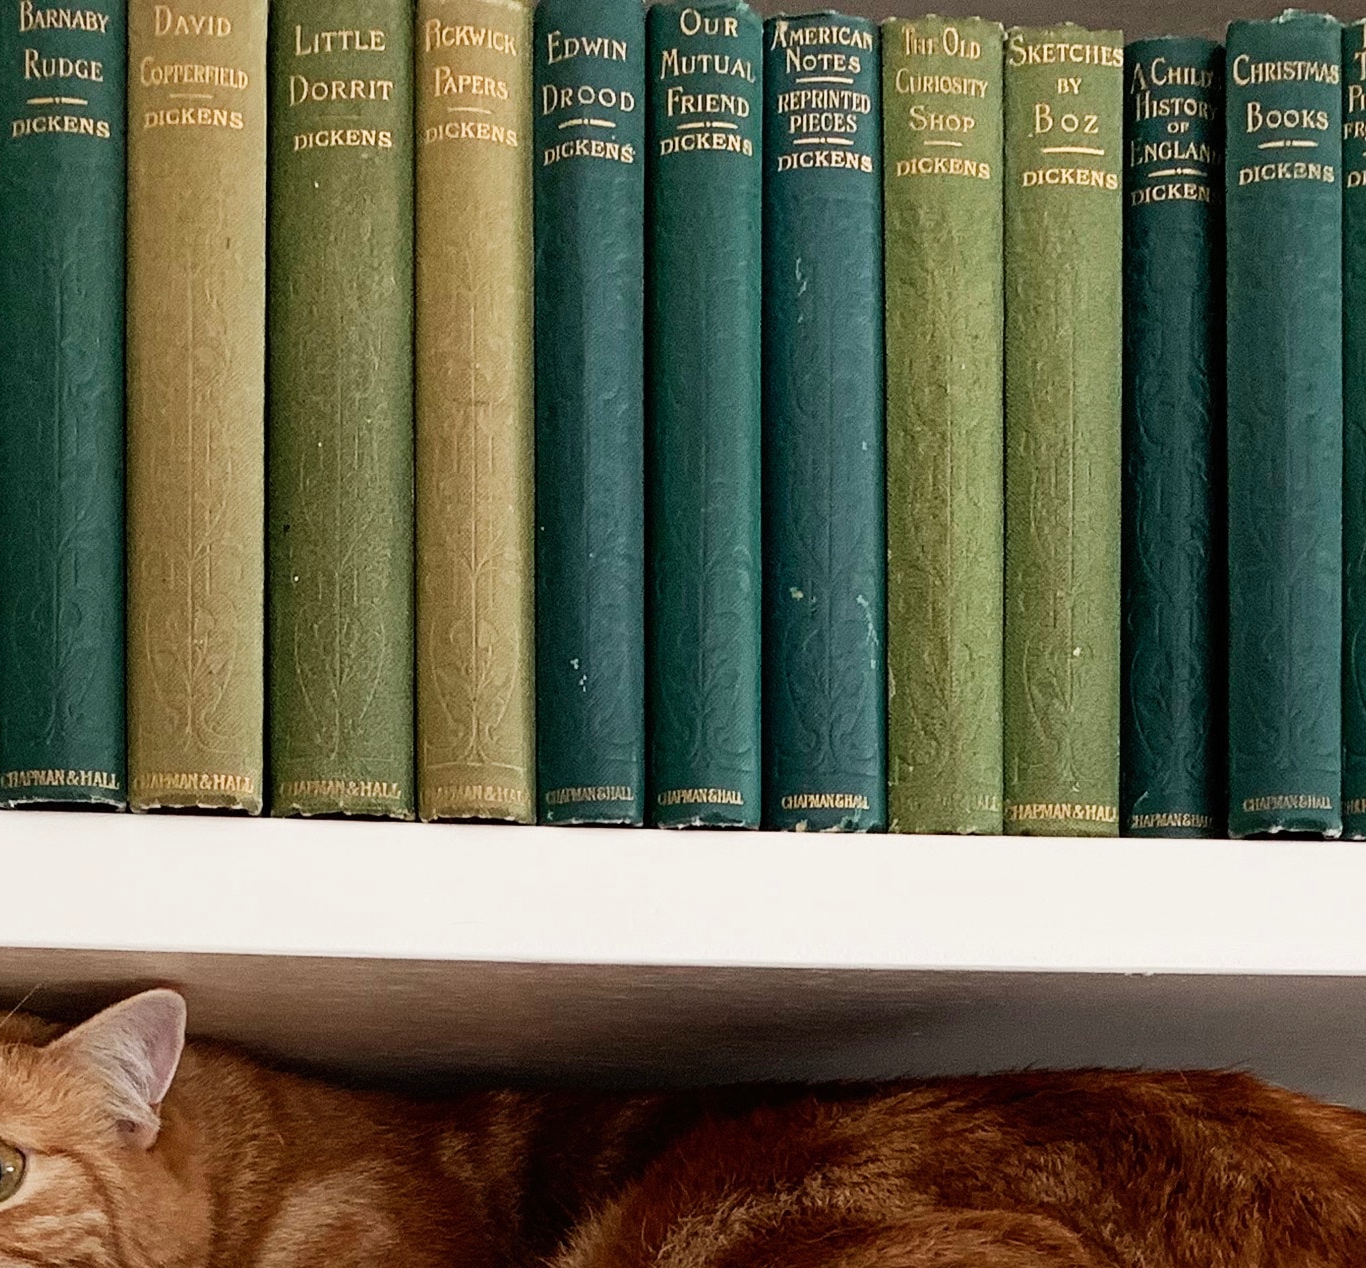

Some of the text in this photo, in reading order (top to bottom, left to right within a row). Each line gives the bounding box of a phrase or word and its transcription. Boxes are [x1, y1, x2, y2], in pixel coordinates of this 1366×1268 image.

[1056, 78, 1081, 94] BY
[777, 91, 871, 115] REPRINTED
[11, 116, 111, 138] DICKENS
[789, 113, 857, 134] PIECES
[659, 133, 753, 157] DICKENS
[1023, 167, 1119, 189] DICKENS
